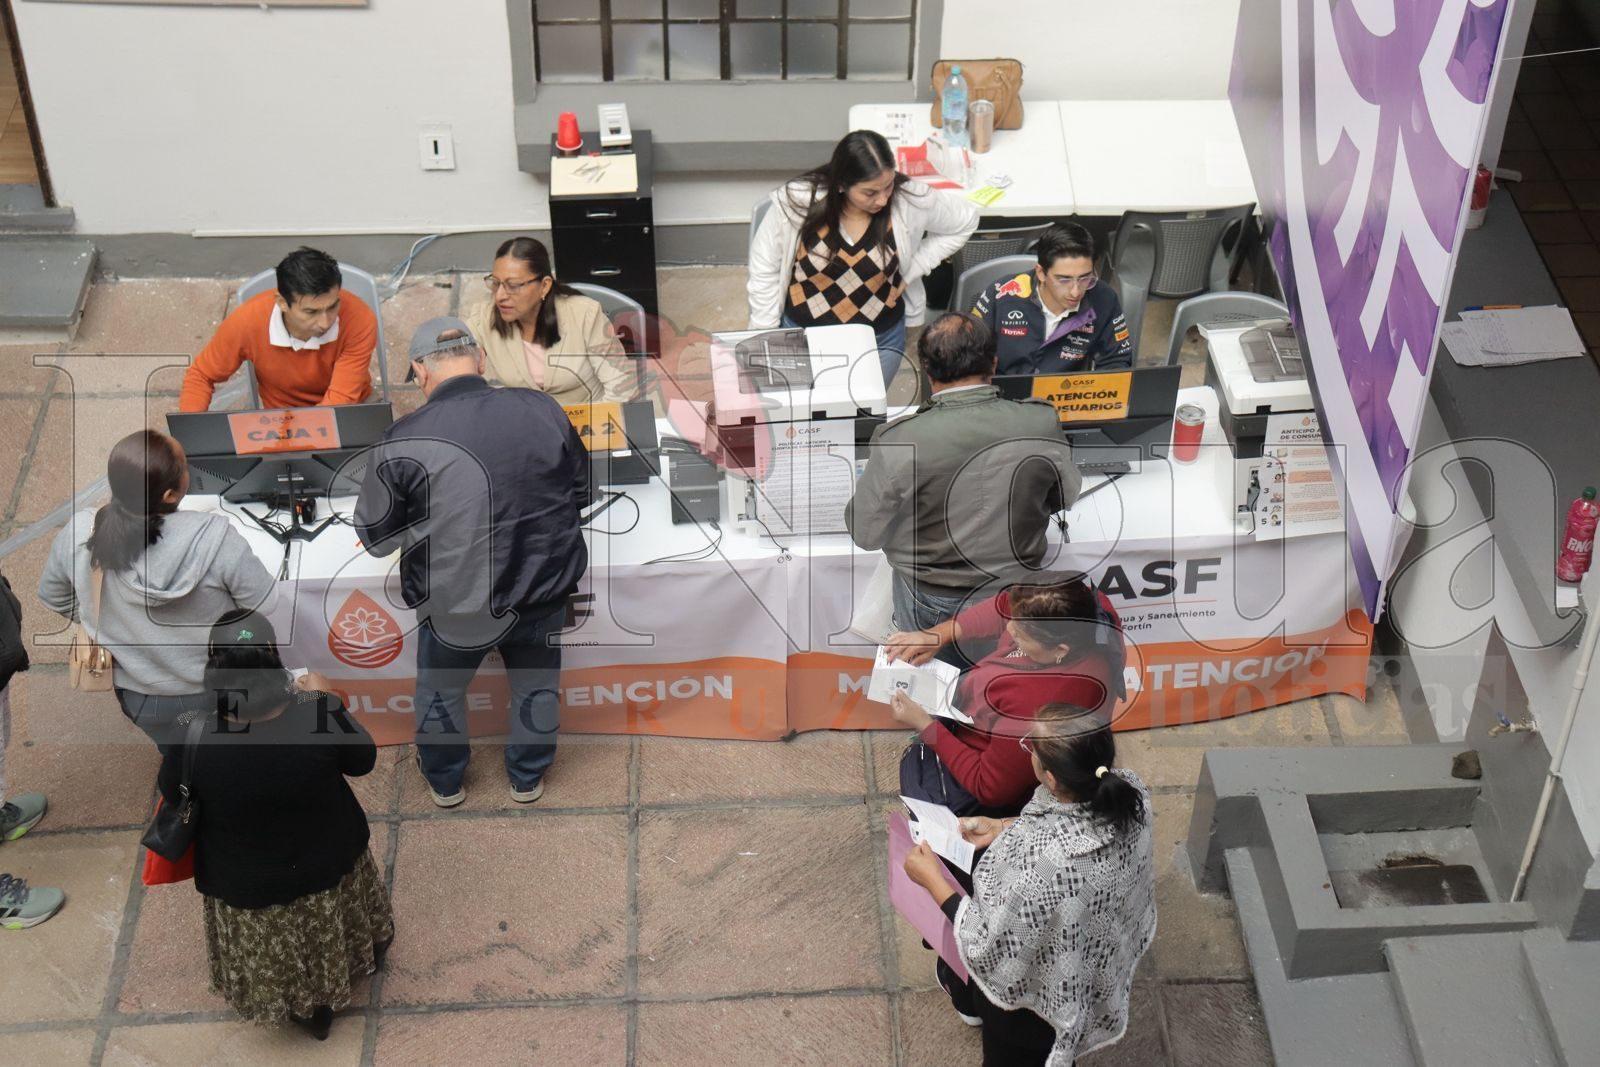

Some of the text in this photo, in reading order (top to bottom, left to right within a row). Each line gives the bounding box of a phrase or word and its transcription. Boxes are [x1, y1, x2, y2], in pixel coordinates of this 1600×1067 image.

[1004, 328, 1025, 336] TOTAL
[1046, 389, 1118, 402] ATENCIÓN
[247, 426, 329, 442] CAJA 1
[601, 422, 616, 435] 2
[798, 427, 822, 435] CASF
[1138, 615, 1145, 623] y
[1147, 610, 1216, 621] Saneamiento
[1121, 622, 1152, 632] Fortín
[1124, 637, 1329, 692] ATENCIÓN
[895, 680, 909, 690] 3
